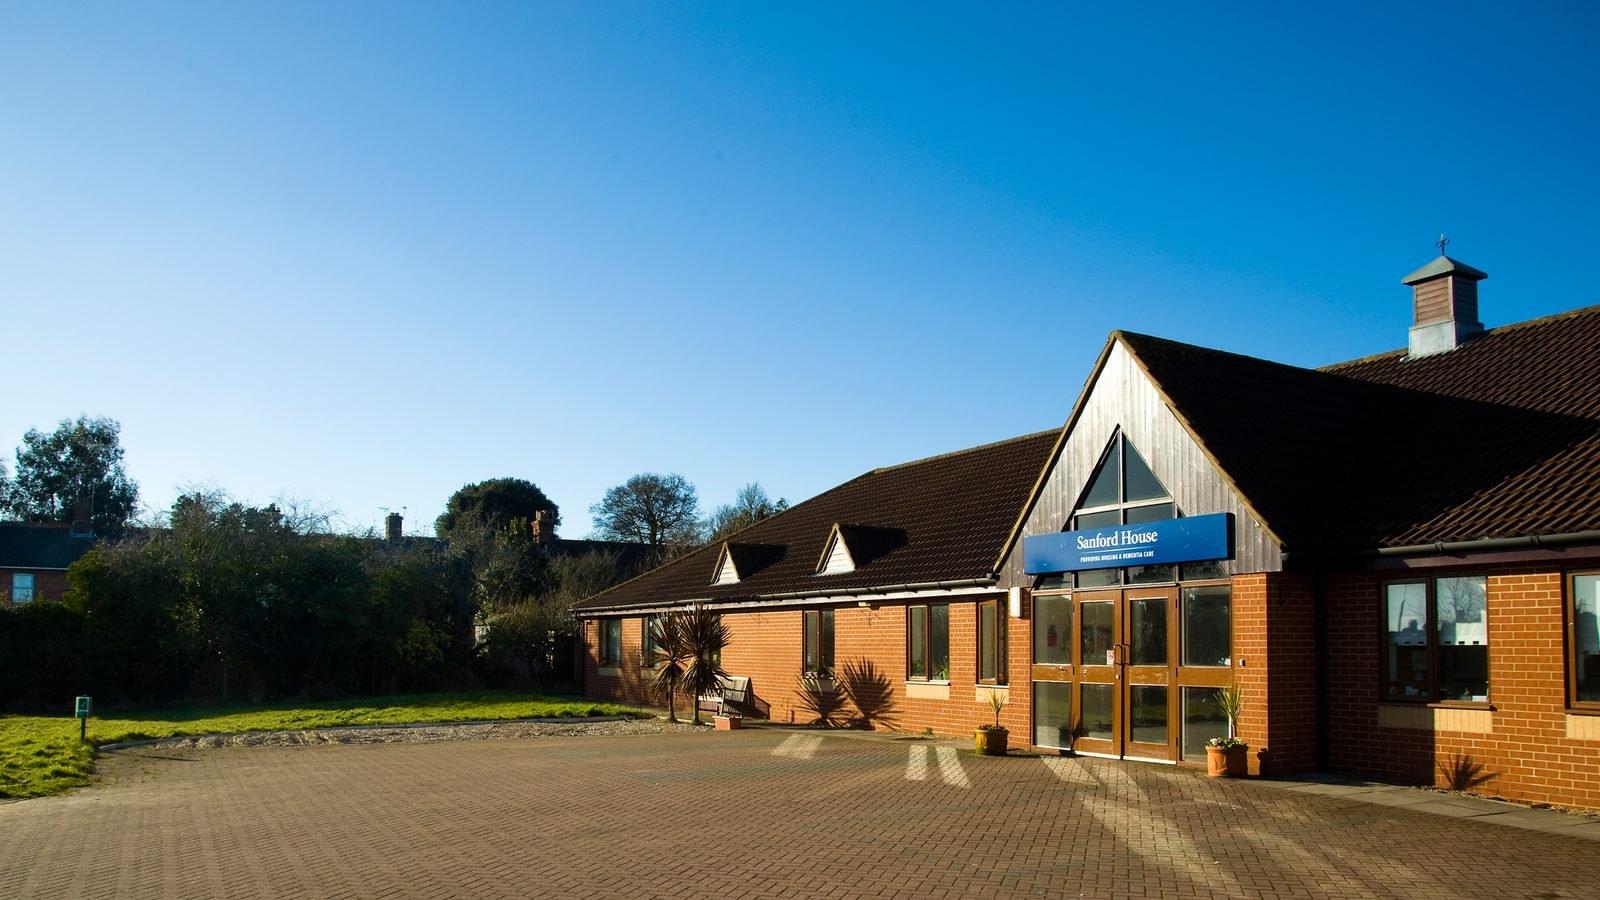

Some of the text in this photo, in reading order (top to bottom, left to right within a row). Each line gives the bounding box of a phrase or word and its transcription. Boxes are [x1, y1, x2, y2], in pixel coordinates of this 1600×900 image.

[1076, 530, 1158, 550] Sanford House
[1080, 555, 1100, 563] PROVIDING
